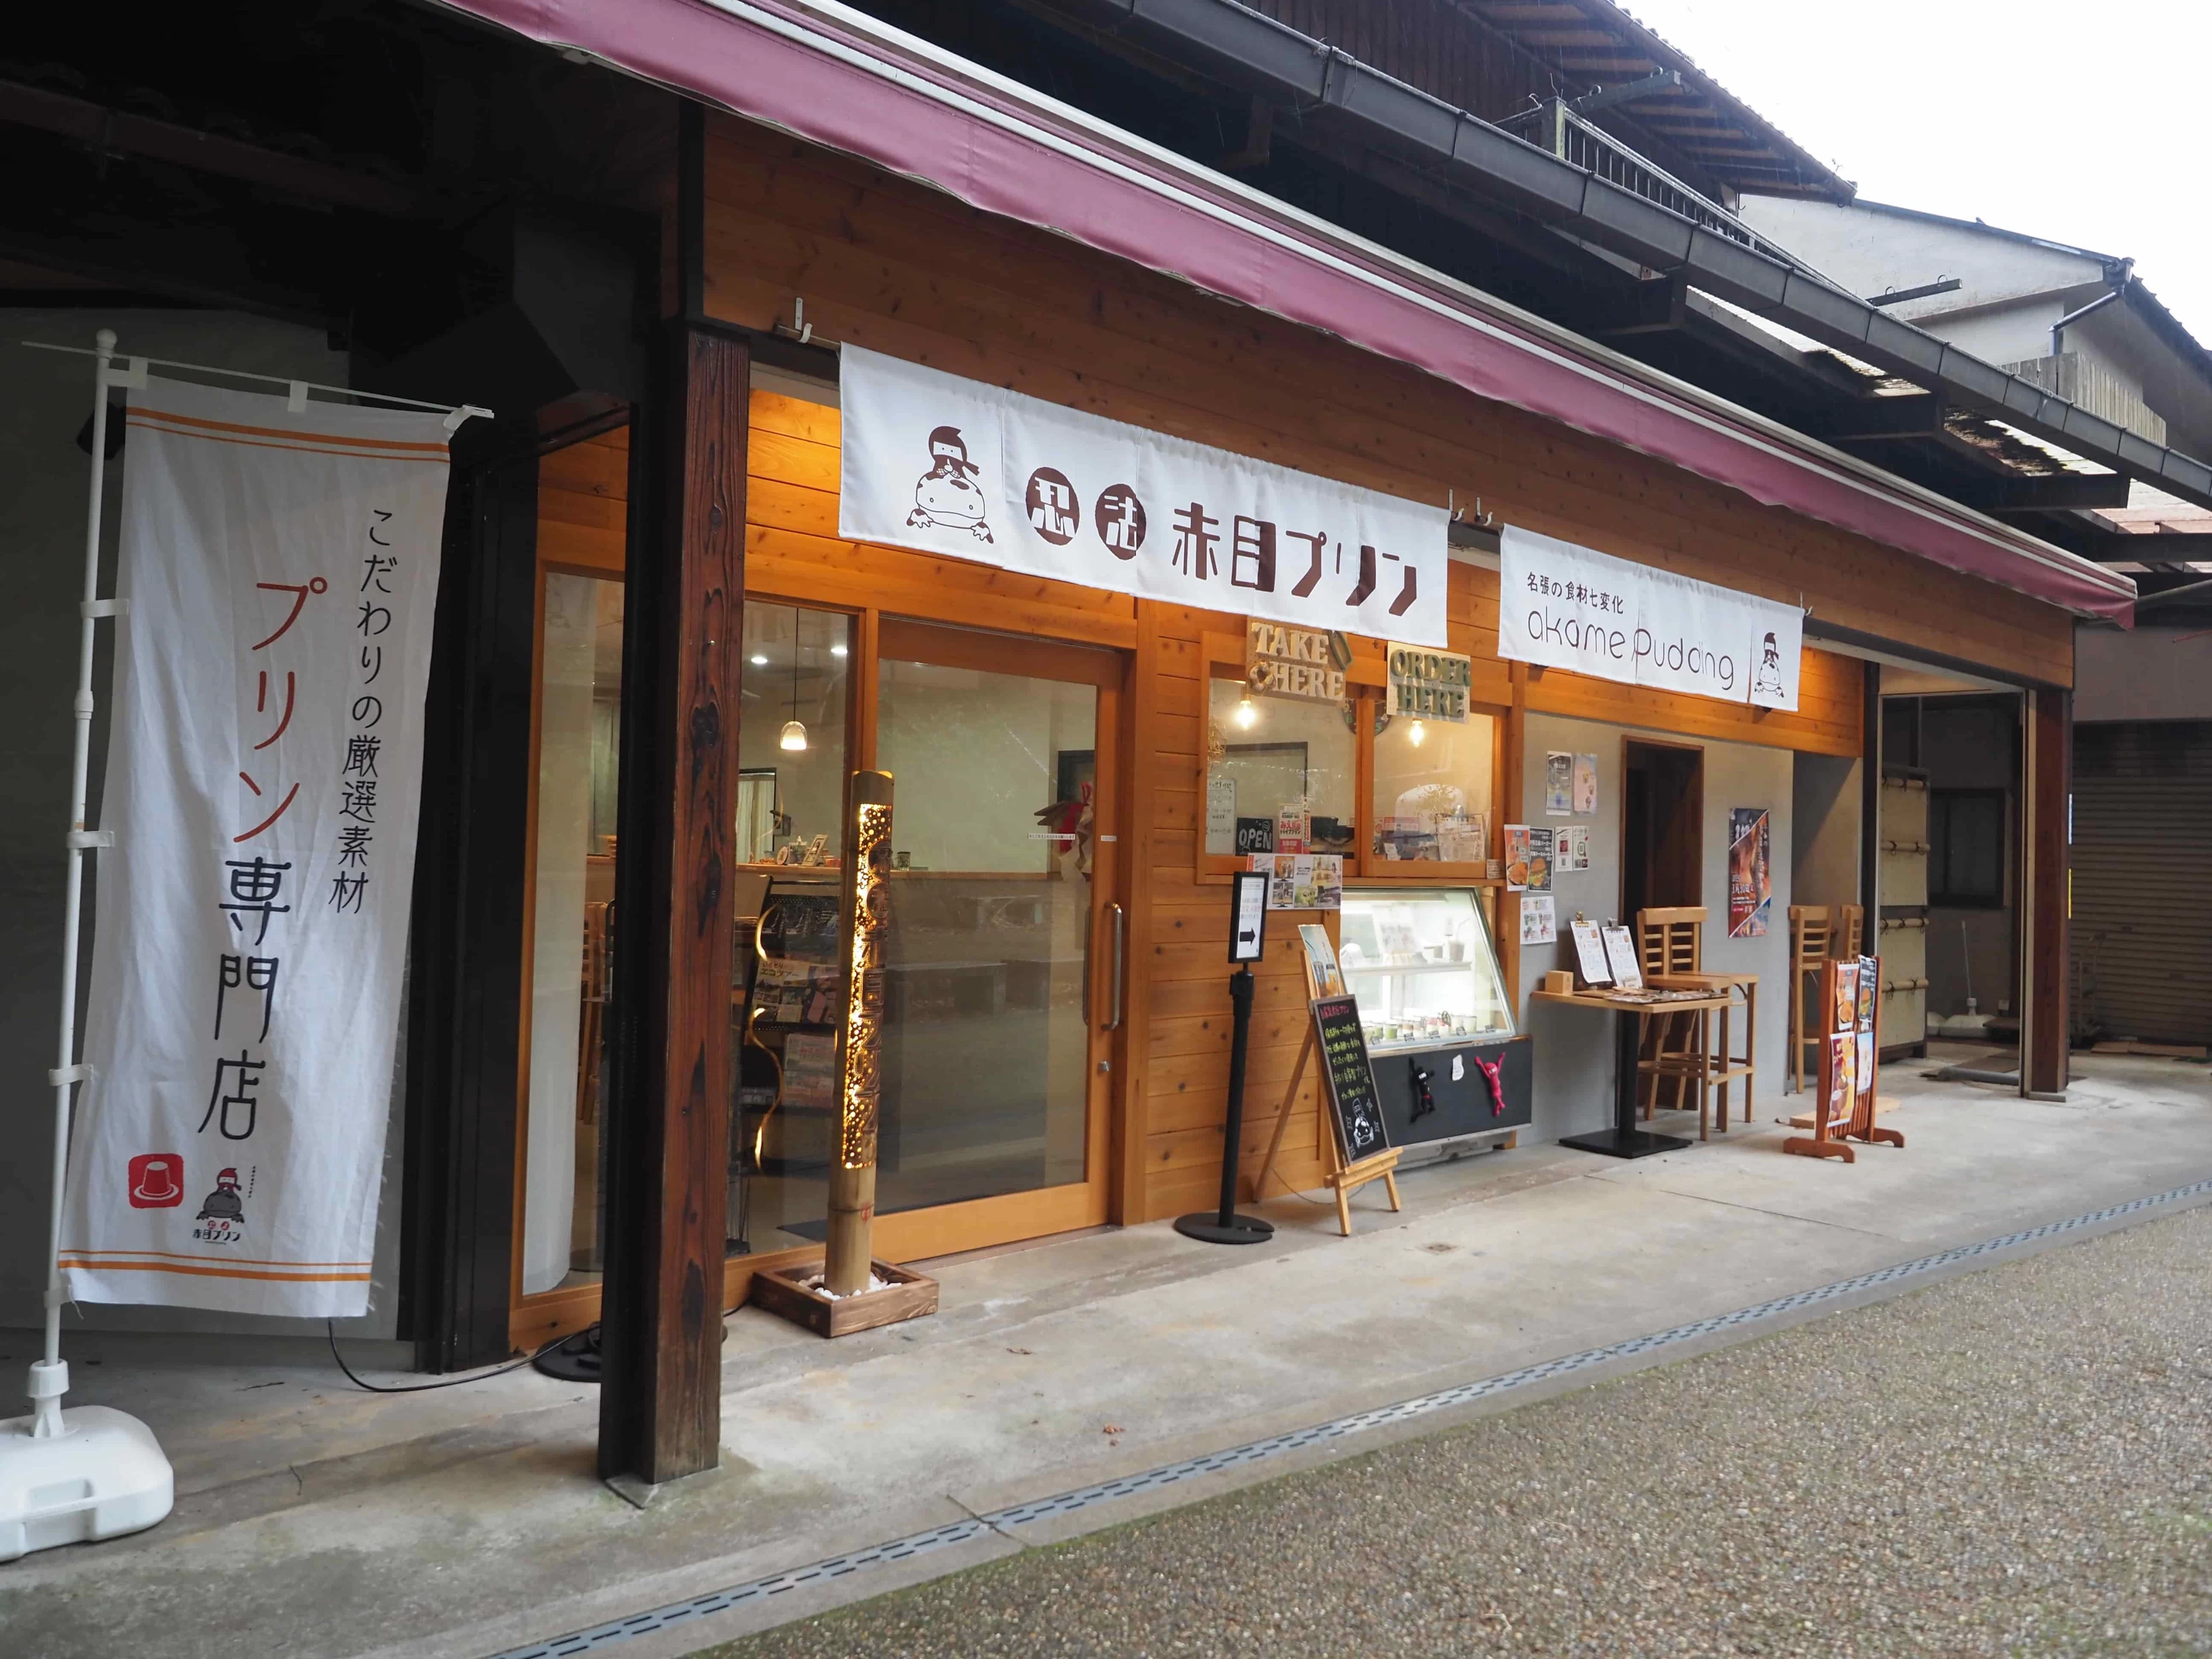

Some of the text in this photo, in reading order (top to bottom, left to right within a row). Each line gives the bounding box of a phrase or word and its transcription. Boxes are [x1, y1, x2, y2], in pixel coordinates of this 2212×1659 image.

[1526, 571, 1624, 615] 名張の食材七変化
[1251, 622, 1329, 664] TAKE
[1528, 605, 1626, 659] akame
[1273, 661, 1344, 701] HERE
[1390, 648, 1472, 687] ORDER
[328, 509, 397, 914] こだわりの厳選素材
[1397, 684, 1465, 718] HERE
[198, 576, 328, 1141] プリン専門店
[1239, 827, 1272, 850] OPEN
